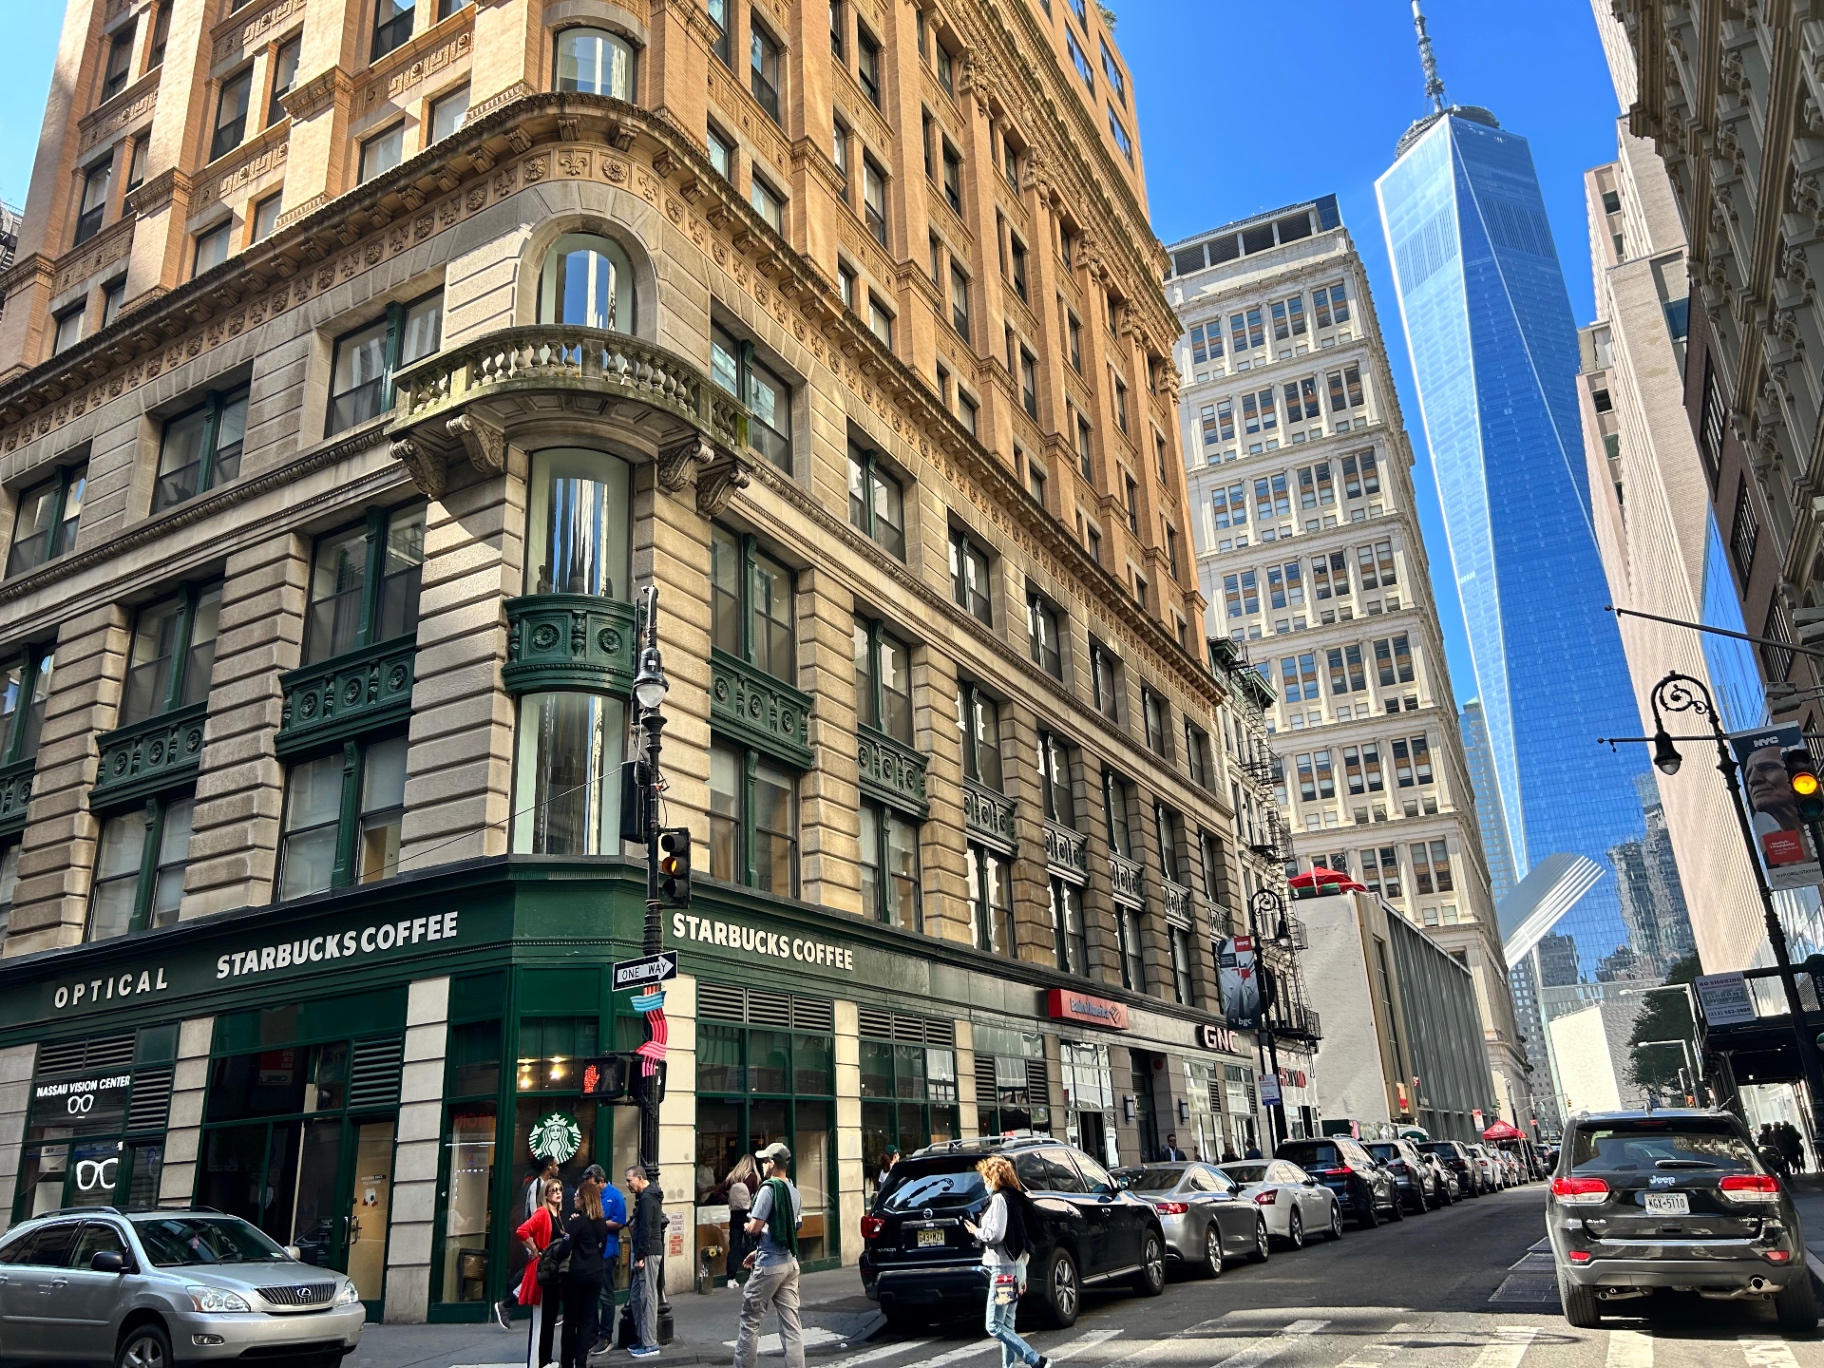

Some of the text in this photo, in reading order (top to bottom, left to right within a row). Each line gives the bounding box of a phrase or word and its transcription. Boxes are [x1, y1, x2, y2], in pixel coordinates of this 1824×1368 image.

[1753, 735, 1779, 748] NYC
[216, 911, 459, 979] STARBUCKS COFFEE
[672, 912, 853, 971] STARBUCKS COFFEE
[621, 962, 668, 981] ONE WAY
[54, 966, 168, 1009] OPTICAL
[1238, 1017, 1252, 1027] bgc
[1203, 1024, 1241, 1054] GNC
[36, 1075, 131, 1098] NASSAU VISION CENTER
[1649, 1174, 1676, 1186] Jeep
